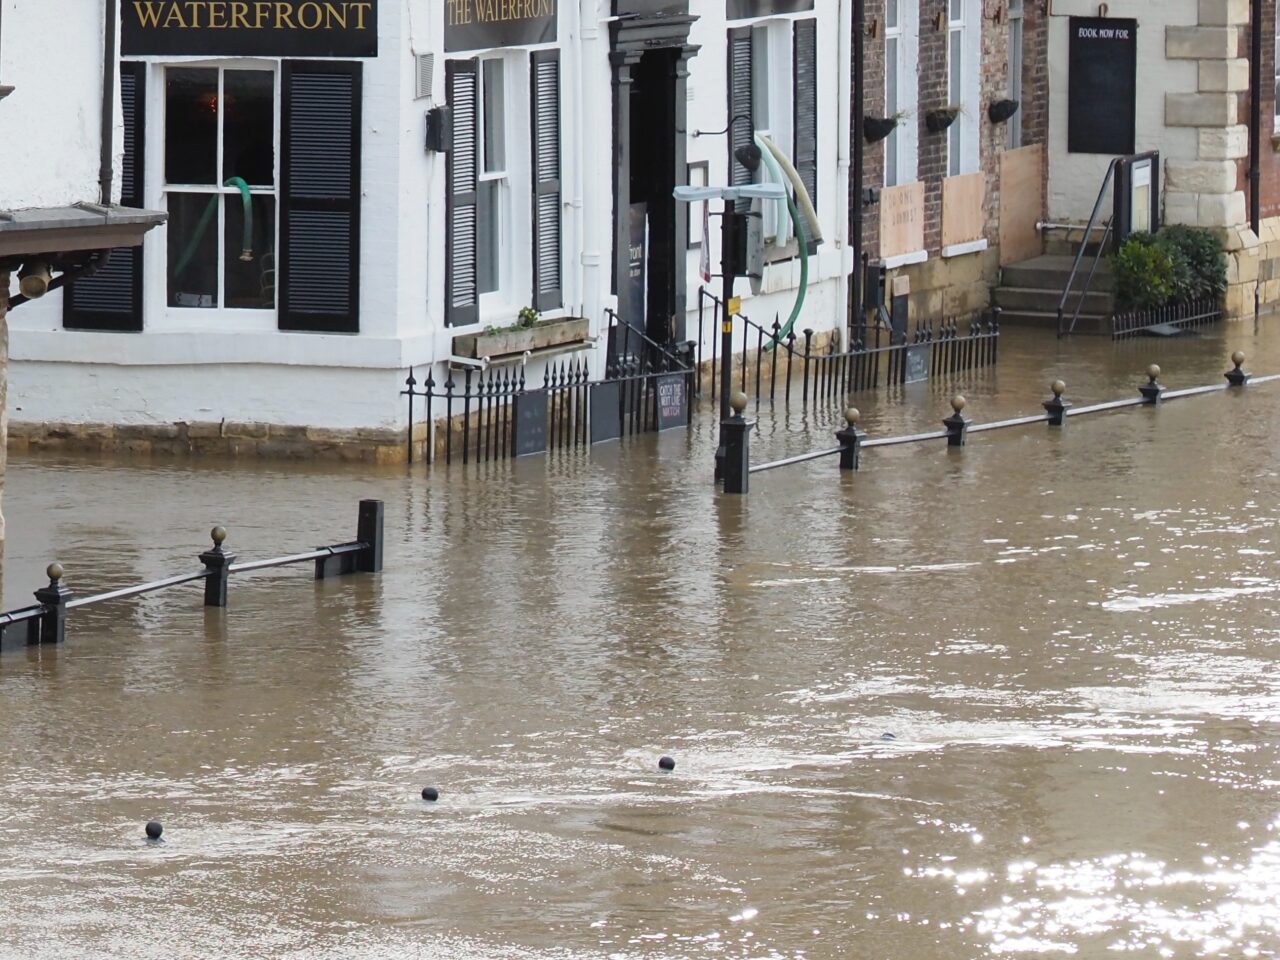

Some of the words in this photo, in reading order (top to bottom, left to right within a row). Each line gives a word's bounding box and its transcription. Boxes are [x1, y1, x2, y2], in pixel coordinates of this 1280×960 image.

[132, 0, 372, 30] WATERFRONT
[1078, 27, 1098, 38] BOOK
[1099, 28, 1114, 39] NOW
[1115, 28, 1129, 39] FOR
